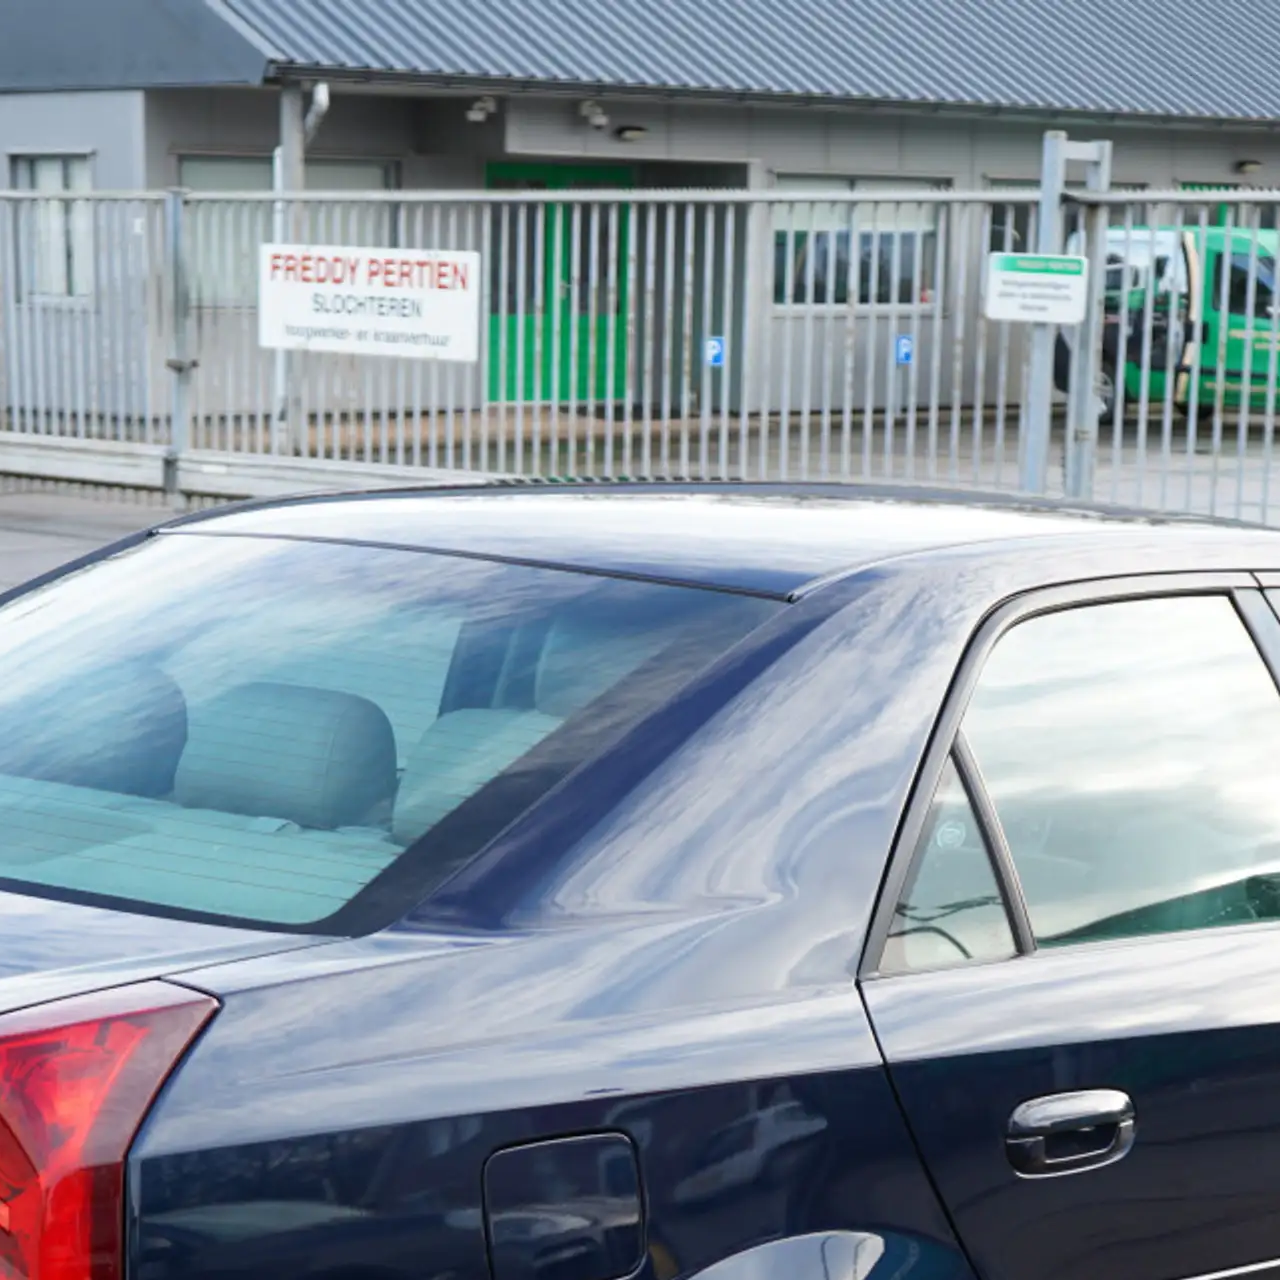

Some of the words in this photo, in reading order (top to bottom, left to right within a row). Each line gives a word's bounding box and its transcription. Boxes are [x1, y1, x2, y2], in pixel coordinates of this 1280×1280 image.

[270, 253, 359, 286] FREDDY
[367, 258, 469, 291] PERTIEN
[312, 292, 423, 318] SLOCHTEREN
